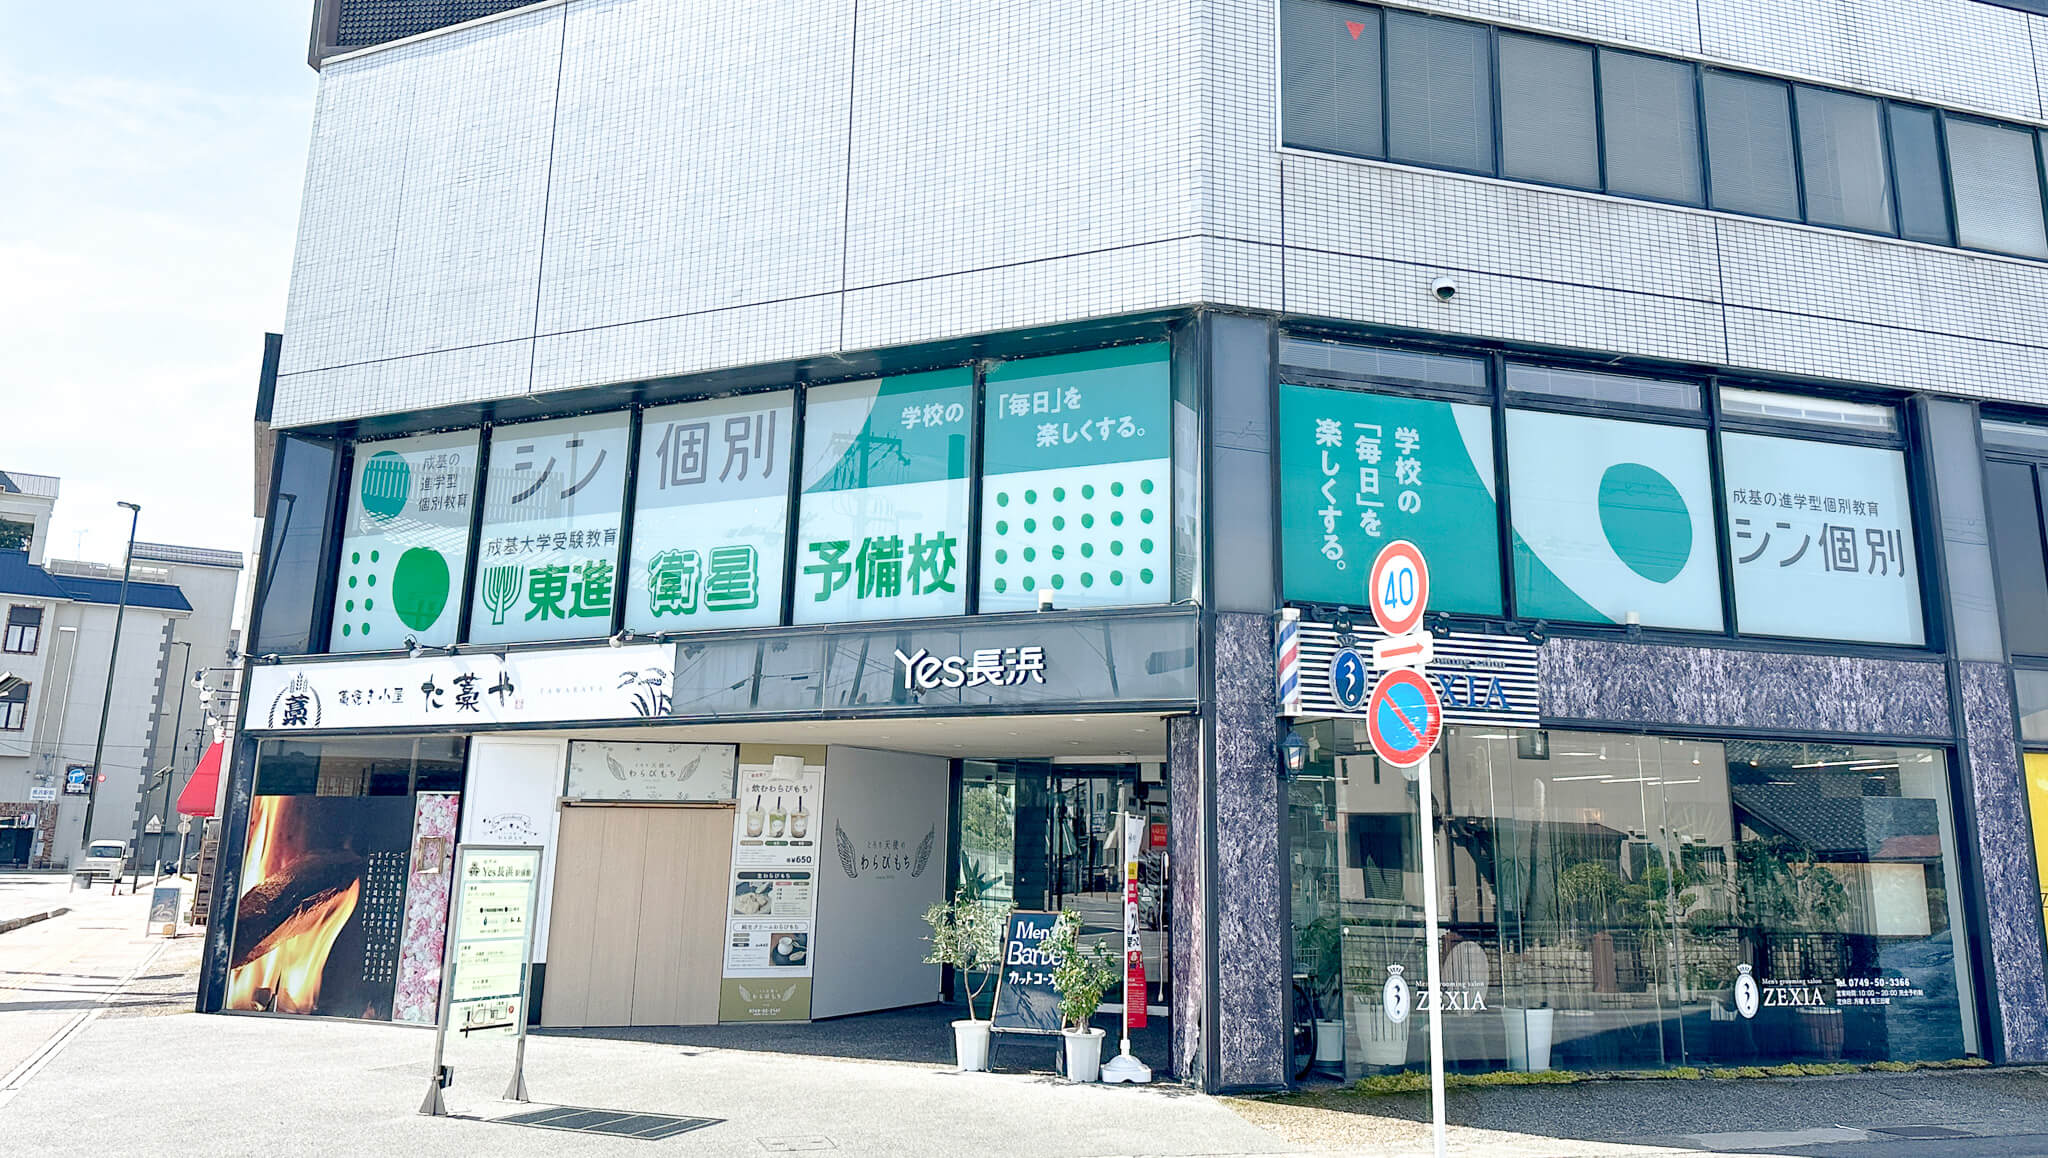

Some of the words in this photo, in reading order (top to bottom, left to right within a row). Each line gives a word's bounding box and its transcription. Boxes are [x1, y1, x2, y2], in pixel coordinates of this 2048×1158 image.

[901, 402, 964, 430] 学校の
[998, 385, 1082, 418] 「毎日」を
[1036, 415, 1147, 447] 楽しくする。
[423, 452, 460, 470] 成基の
[512, 439, 607, 504] シン
[656, 410, 776, 490] 個別
[1394, 426, 1422, 515] 学校の
[420, 472, 457, 490] 進学型
[1315, 418, 1346, 570] 楽しくする。
[1354, 422, 1384, 537] 「毎日」を
[419, 493, 468, 512] 個別教育
[1733, 488, 1879, 517] 成基の進学型個別教育
[487, 527, 617, 557] 成基大学受験教育
[1735, 518, 1905, 578] シン個別
[525, 559, 615, 622] 東進
[648, 544, 759, 618] 衛星
[804, 530, 957, 603] 予備校
[1384, 567, 1414, 609] 40
[894, 645, 1046, 690] Yes長浜
[860, 853, 910, 871] わらびもち
[1763, 987, 1825, 1007] ZEXIA
